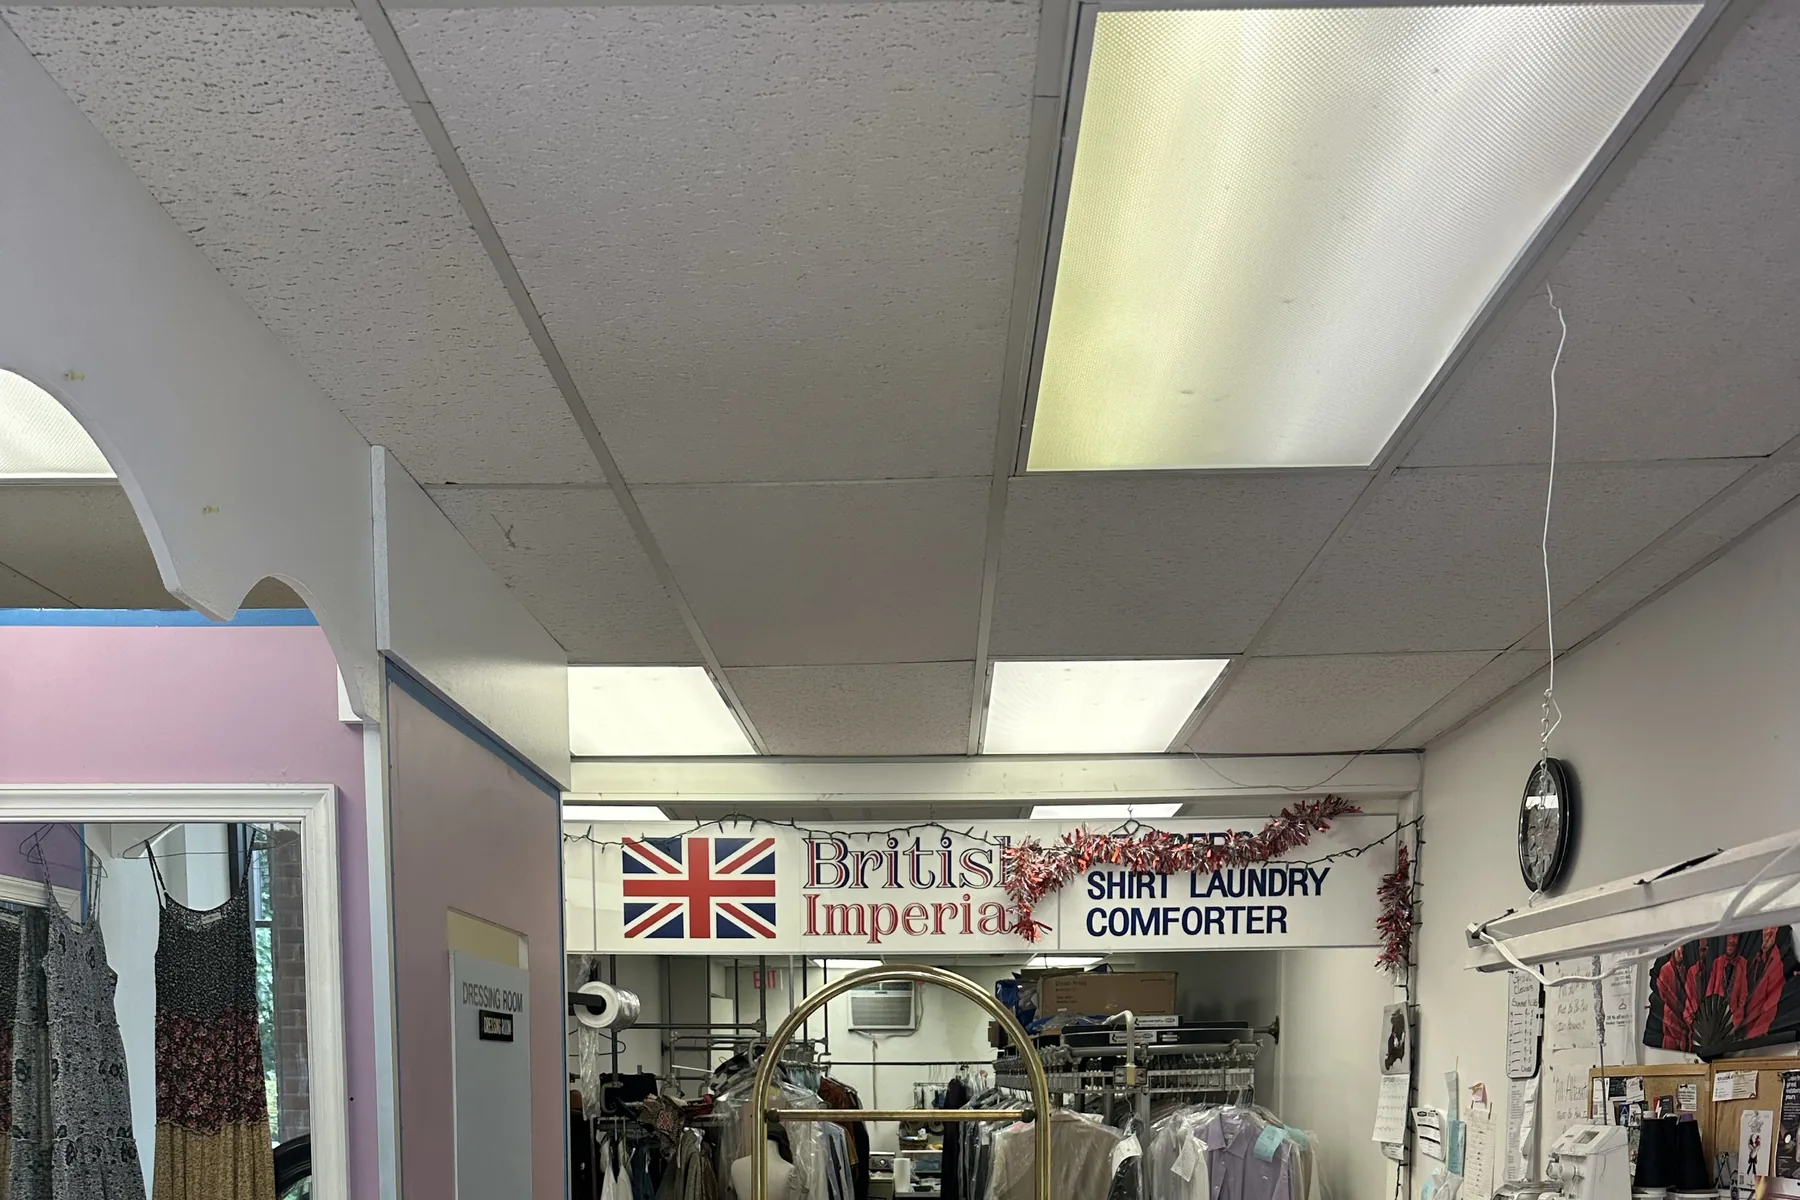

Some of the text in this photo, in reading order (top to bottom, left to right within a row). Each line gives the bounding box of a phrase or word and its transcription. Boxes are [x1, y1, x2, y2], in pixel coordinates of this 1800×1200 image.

[1087, 867, 1331, 900] SHIRT LAUNDRY
[803, 893, 1014, 944] Imperia
[1086, 905, 1288, 937] COMFORTER
[753, 969, 777, 989] EIT
[463, 982, 524, 1013] DRESSING ROOM
